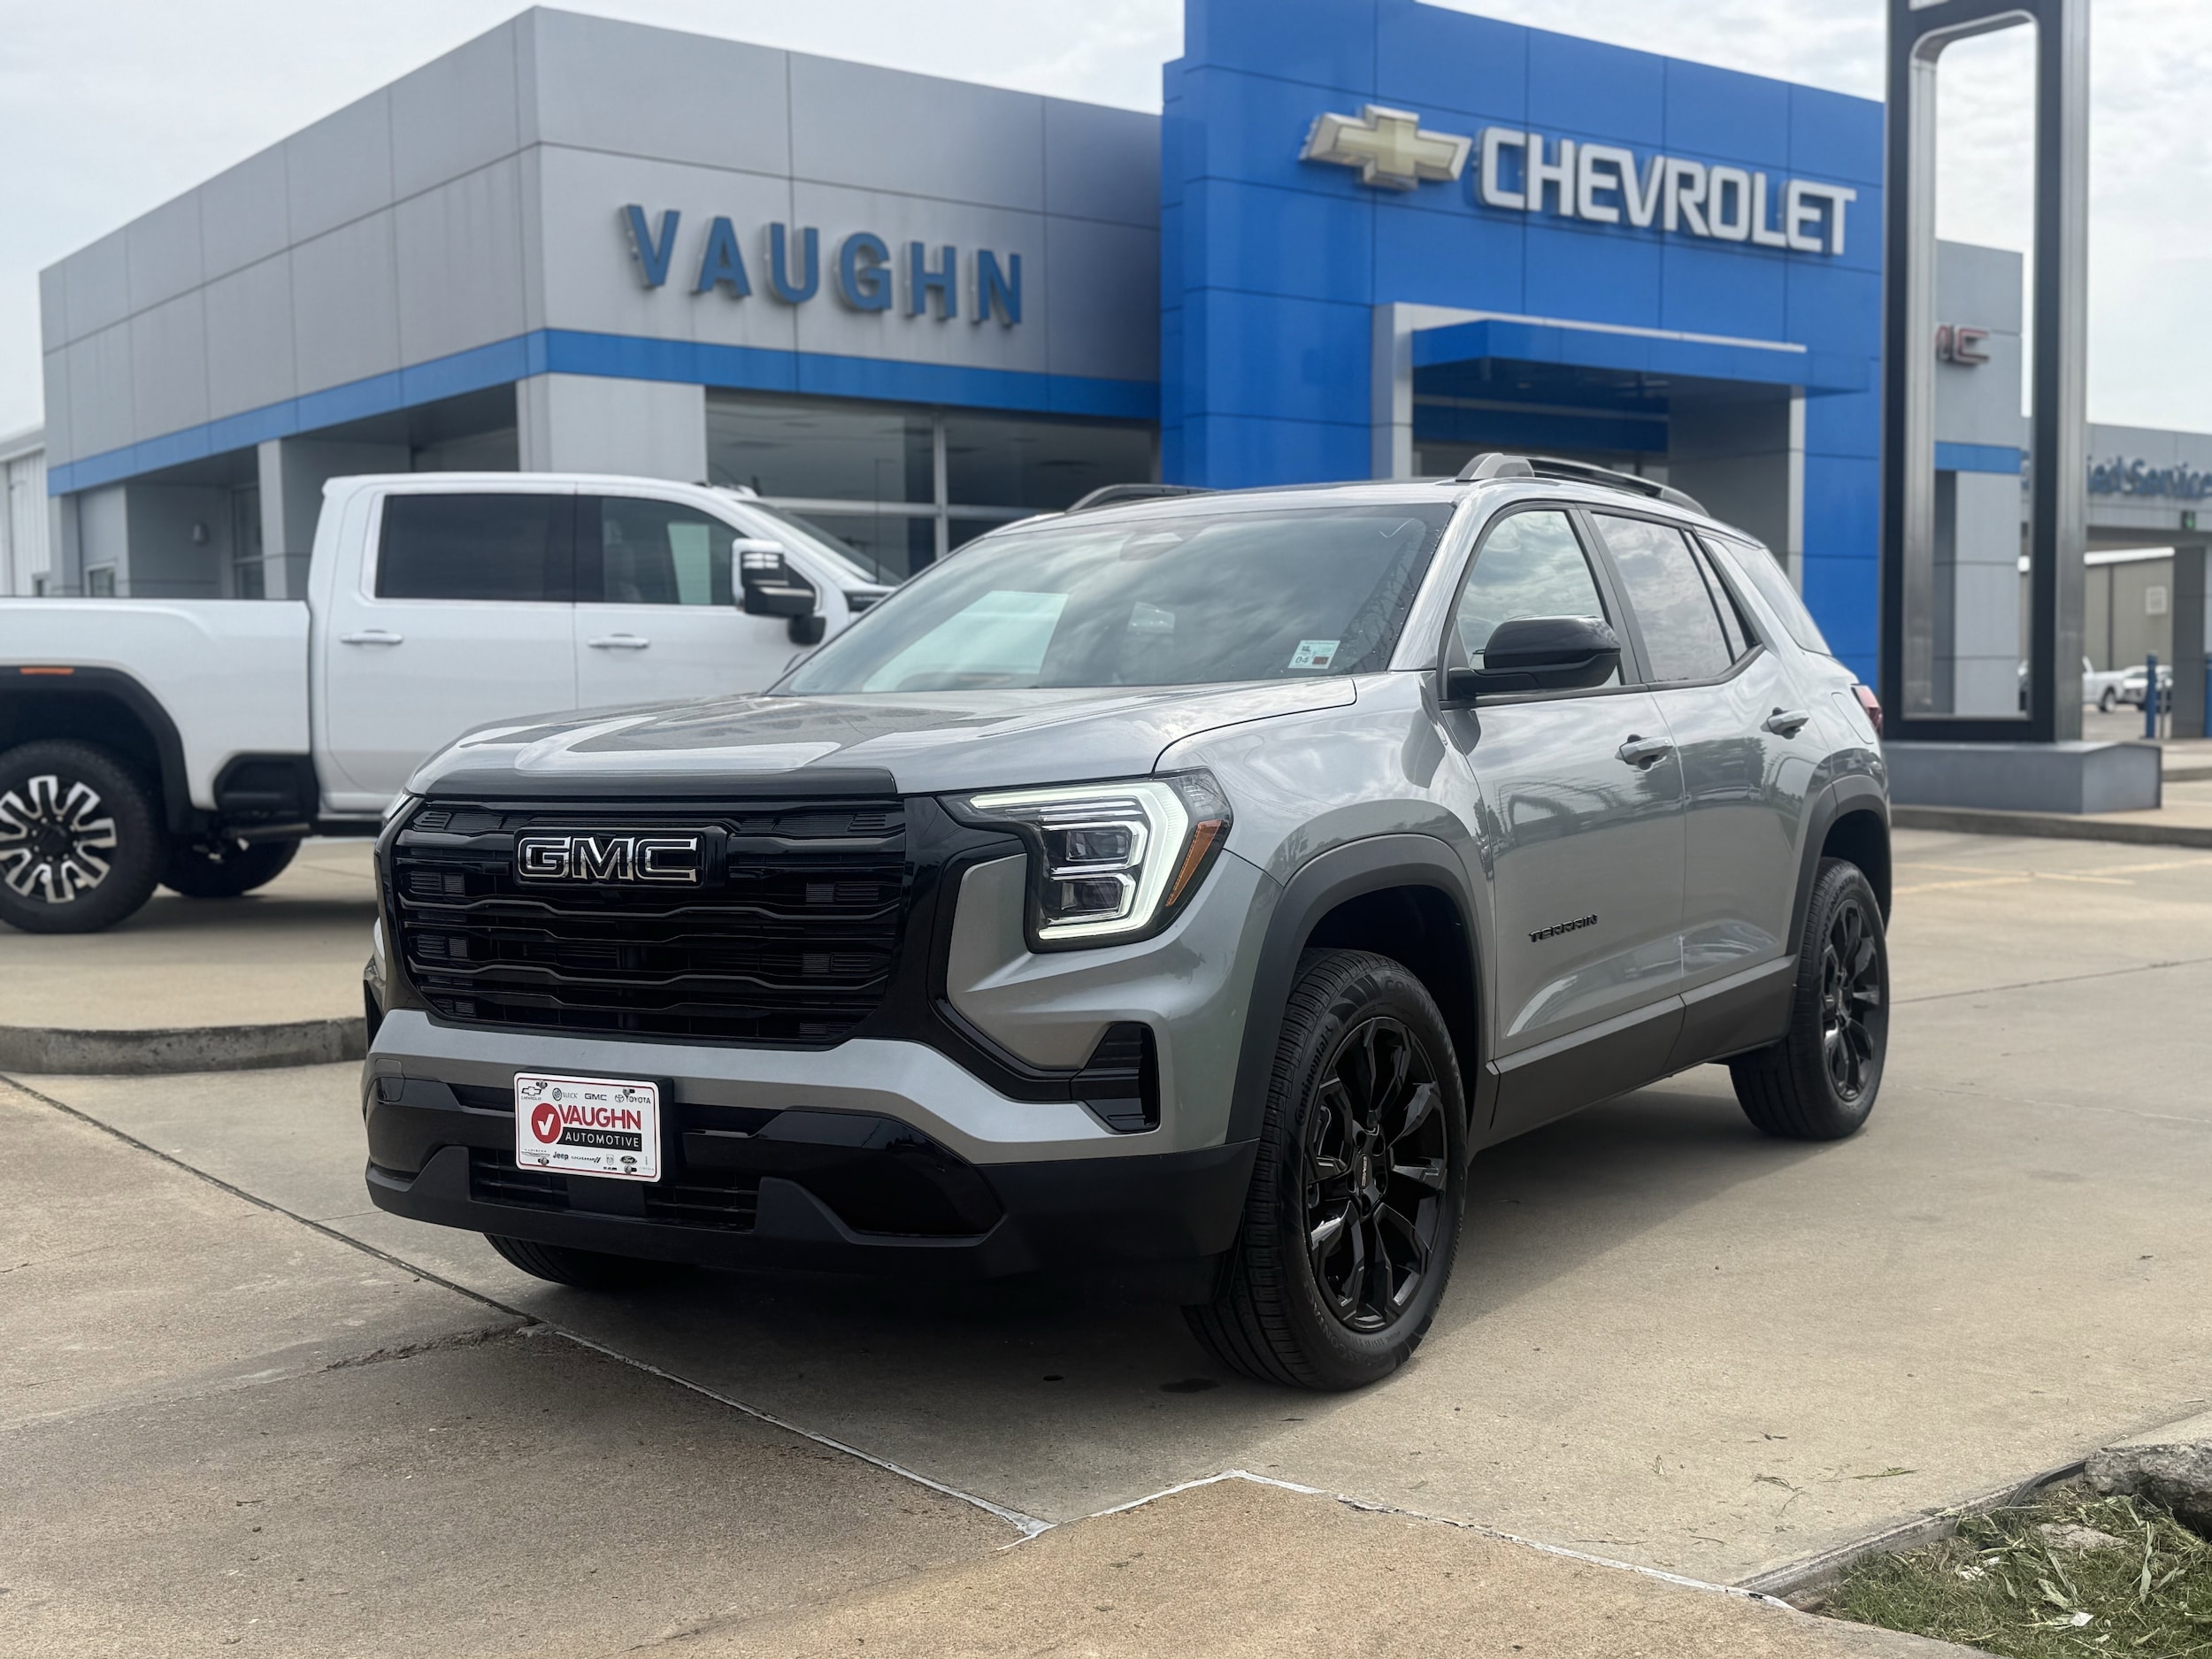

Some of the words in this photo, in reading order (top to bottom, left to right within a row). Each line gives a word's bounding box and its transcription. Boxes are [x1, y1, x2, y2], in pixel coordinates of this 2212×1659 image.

[1478, 126, 1857, 256] CHEVROLET
[619, 203, 1022, 326] VAUGHN
[518, 836, 697, 882] GMC
[1528, 913, 1598, 943] TERRAIN
[1294, 1035, 1330, 1127] Continental
[584, 1093, 608, 1102] GMC
[558, 1104, 641, 1130] VAUGHN
[565, 1133, 640, 1148] AUTOMOTIVE
[552, 1151, 569, 1161] Jeep
